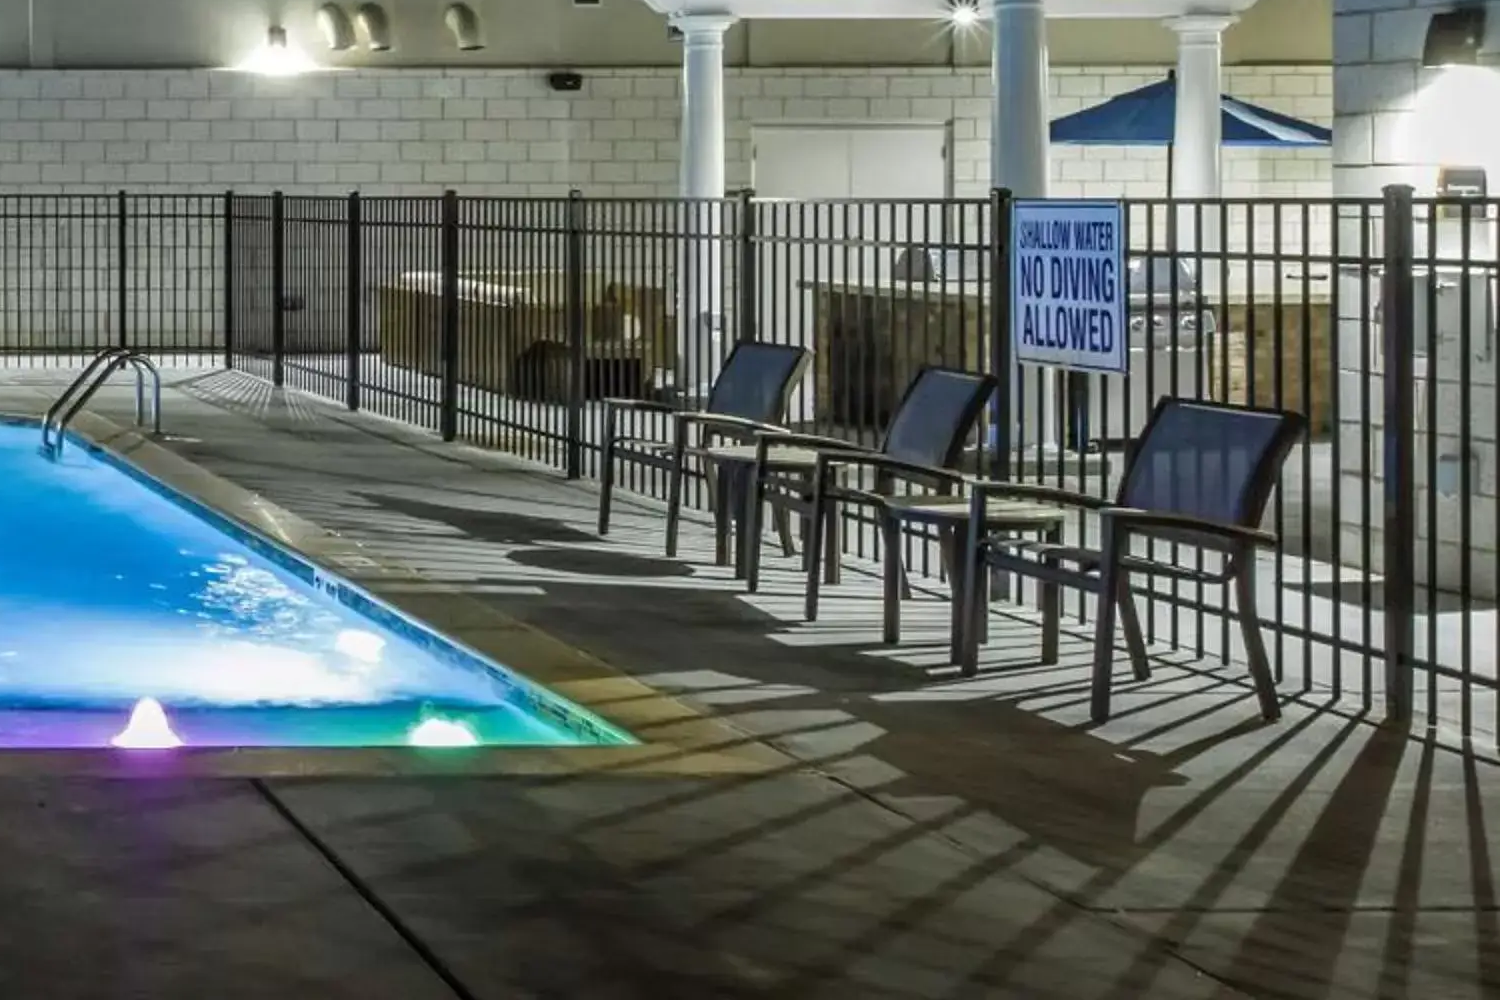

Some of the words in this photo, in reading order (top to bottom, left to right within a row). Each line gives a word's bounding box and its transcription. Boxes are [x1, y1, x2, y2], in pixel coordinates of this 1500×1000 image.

[1020, 220, 1071, 249] SHALLOW
[1074, 221, 1114, 251] WATER
[1021, 255, 1045, 298] NO
[1051, 256, 1115, 303] DIVING
[1023, 304, 1113, 353] ALLOWED
